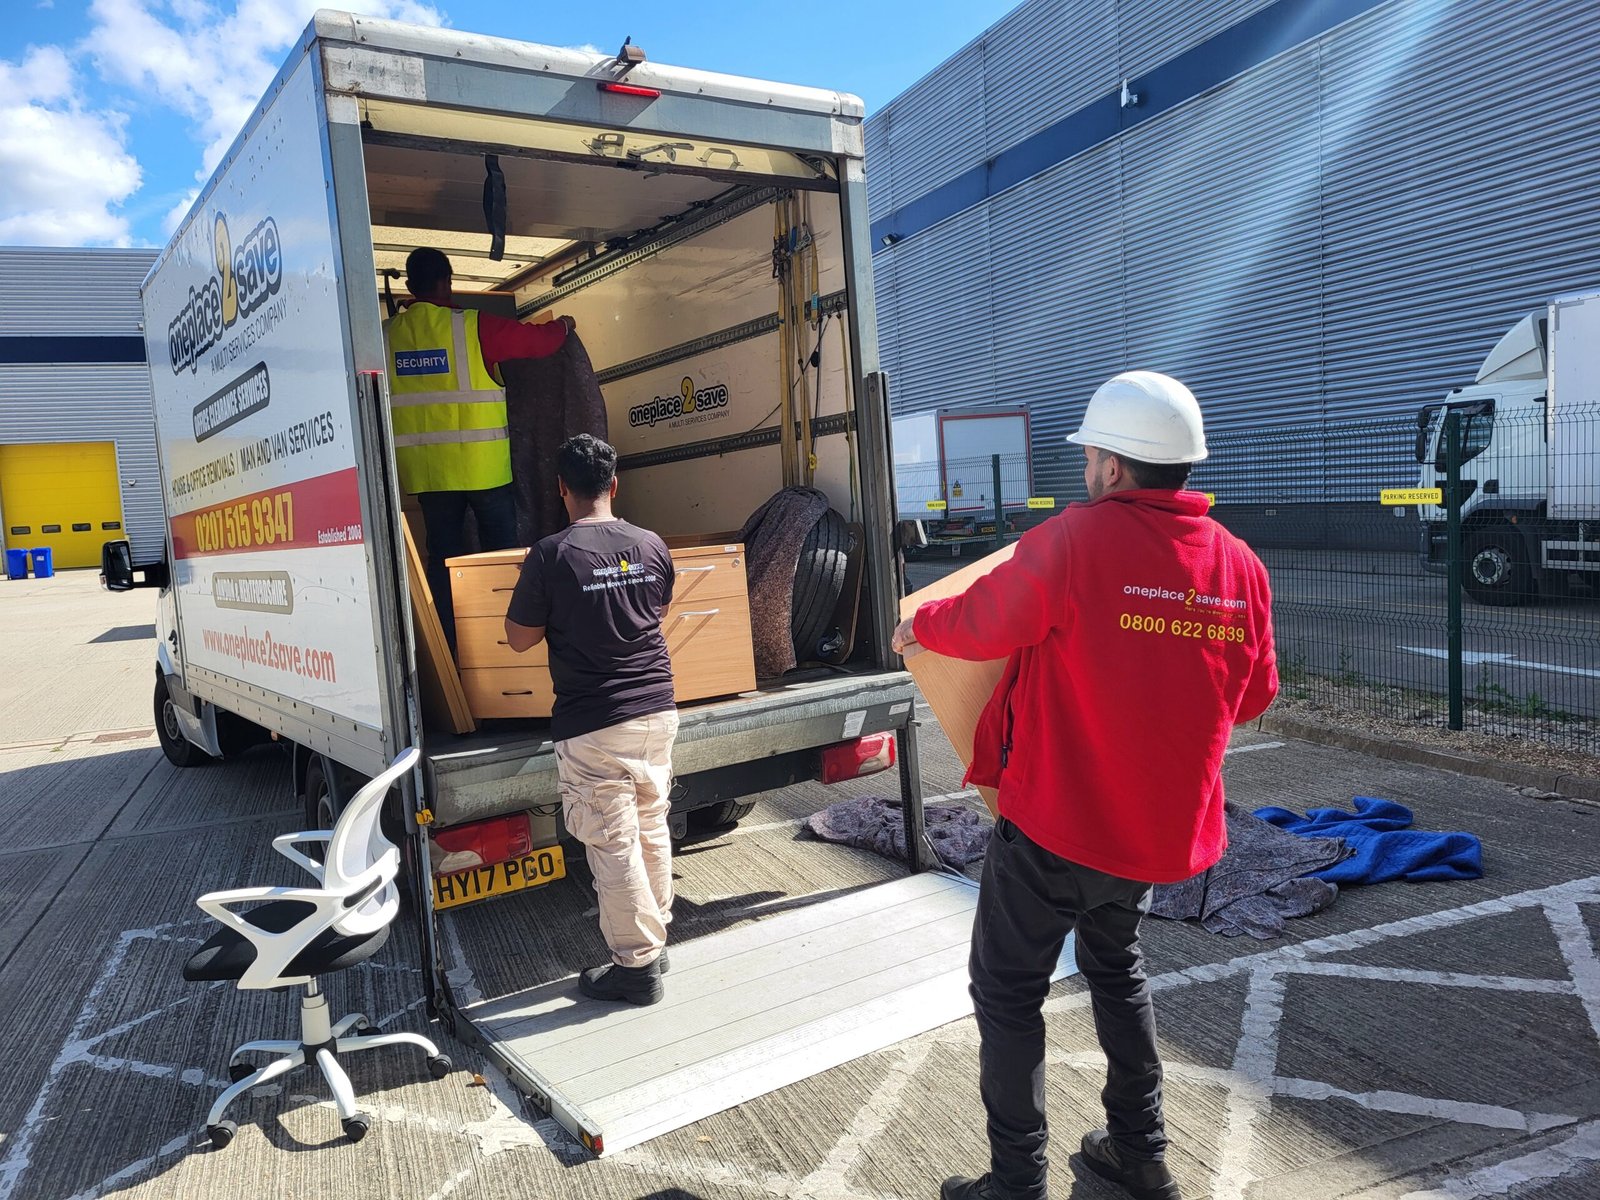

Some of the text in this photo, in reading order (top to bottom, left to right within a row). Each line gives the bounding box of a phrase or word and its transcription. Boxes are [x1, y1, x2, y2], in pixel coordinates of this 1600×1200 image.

[168, 211, 282, 375] oneplace2save
[229, 323, 256, 361] SERVICES
[255, 295, 287, 340] COMPANY
[396, 356, 446, 369] SECURITY
[237, 369, 269, 412] SERVICES
[629, 376, 728, 427] oneplace2save
[685, 414, 706, 426] SERVICES
[707, 409, 730, 420] COMPANY
[171, 476, 187, 498] HOUSE
[189, 465, 207, 491] OFFICE
[206, 453, 235, 483] REMOVALS
[240, 445, 255, 472] MAN
[256, 438, 271, 468] AND
[270, 430, 288, 461] VAN
[288, 411, 334, 455] SERVICES
[1408, 492, 1439, 500] RESERVED
[195, 492, 293, 552] 0207 515 9347
[318, 525, 346, 544] Established
[582, 582, 606, 592] Reliable
[1119, 613, 1245, 643] 0800 622 6839
[202, 625, 336, 683] www.oneplace2save.com
[436, 852, 555, 903] HY17 PGO
